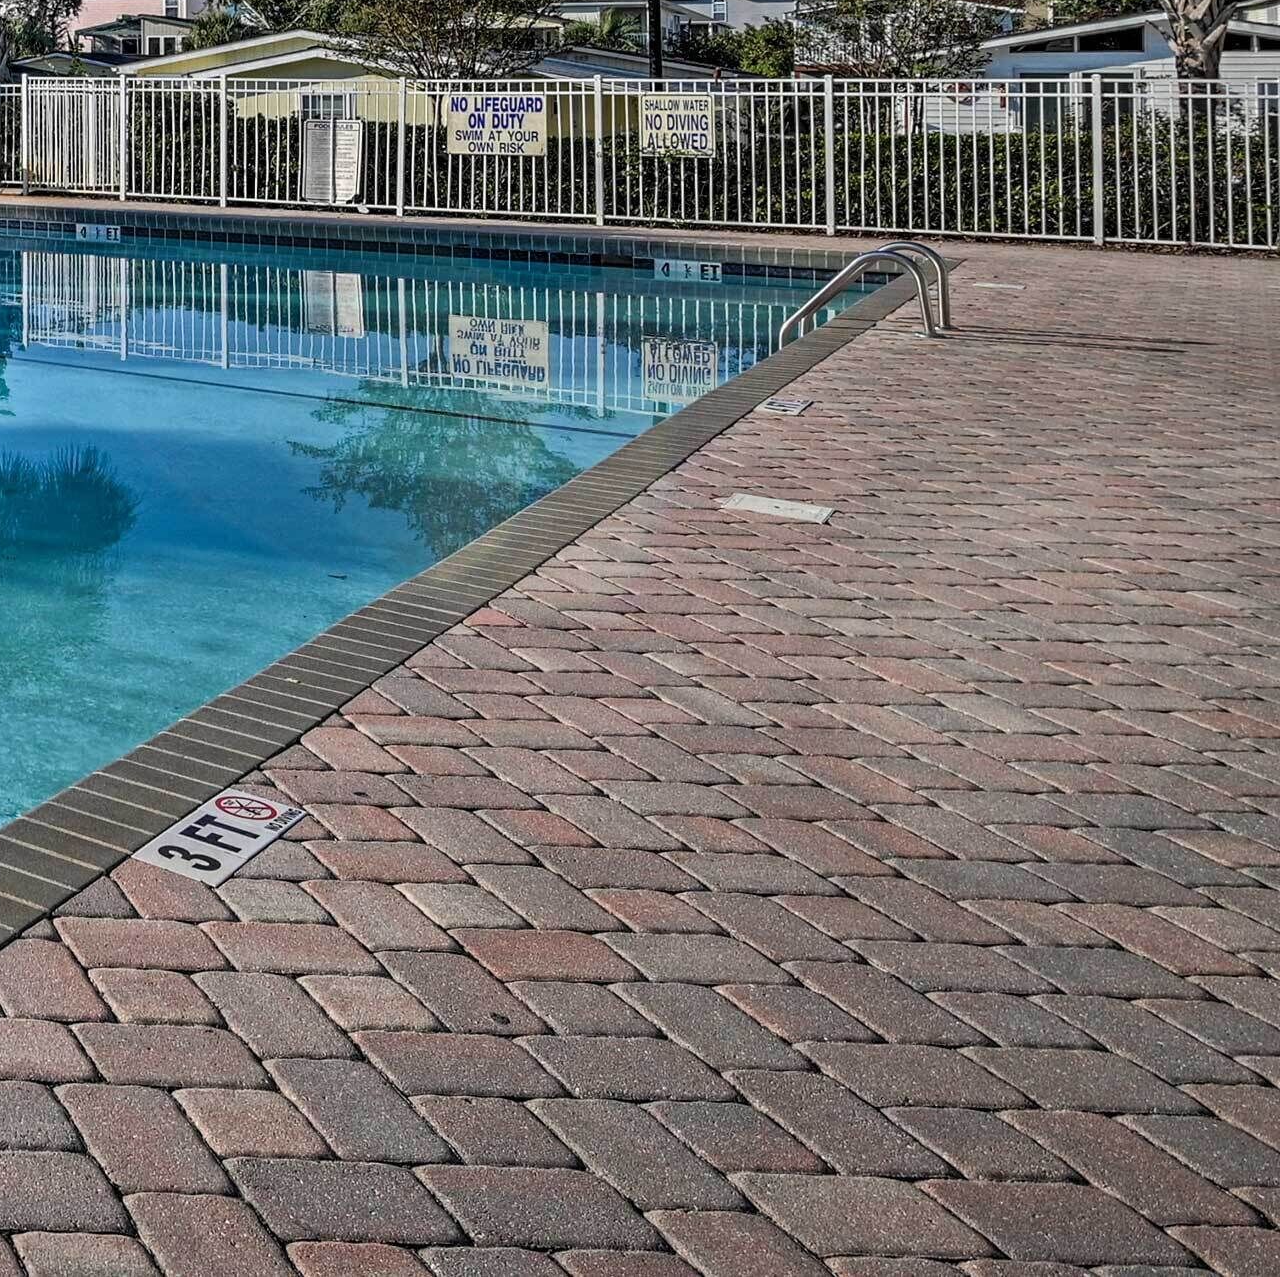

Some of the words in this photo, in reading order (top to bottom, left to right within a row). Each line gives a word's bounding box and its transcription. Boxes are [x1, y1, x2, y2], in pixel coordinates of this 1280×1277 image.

[451, 96, 468, 112] NO
[474, 97, 543, 113] LIFEGUARD
[644, 99, 680, 111] SHALLOW
[683, 100, 709, 111] WATER
[468, 113, 485, 129] ON
[492, 113, 524, 129] DUTY
[645, 113, 662, 130] NO
[667, 114, 708, 131] DIVING
[455, 130, 483, 141] SWIM
[488, 131, 503, 141] AT
[508, 131, 539, 142] YOUR
[647, 132, 708, 150] ALLOWED
[468, 142, 493, 153] OWN
[500, 142, 525, 154] RISK
[178, 814, 261, 854] FT
[158, 845, 222, 871] 3
